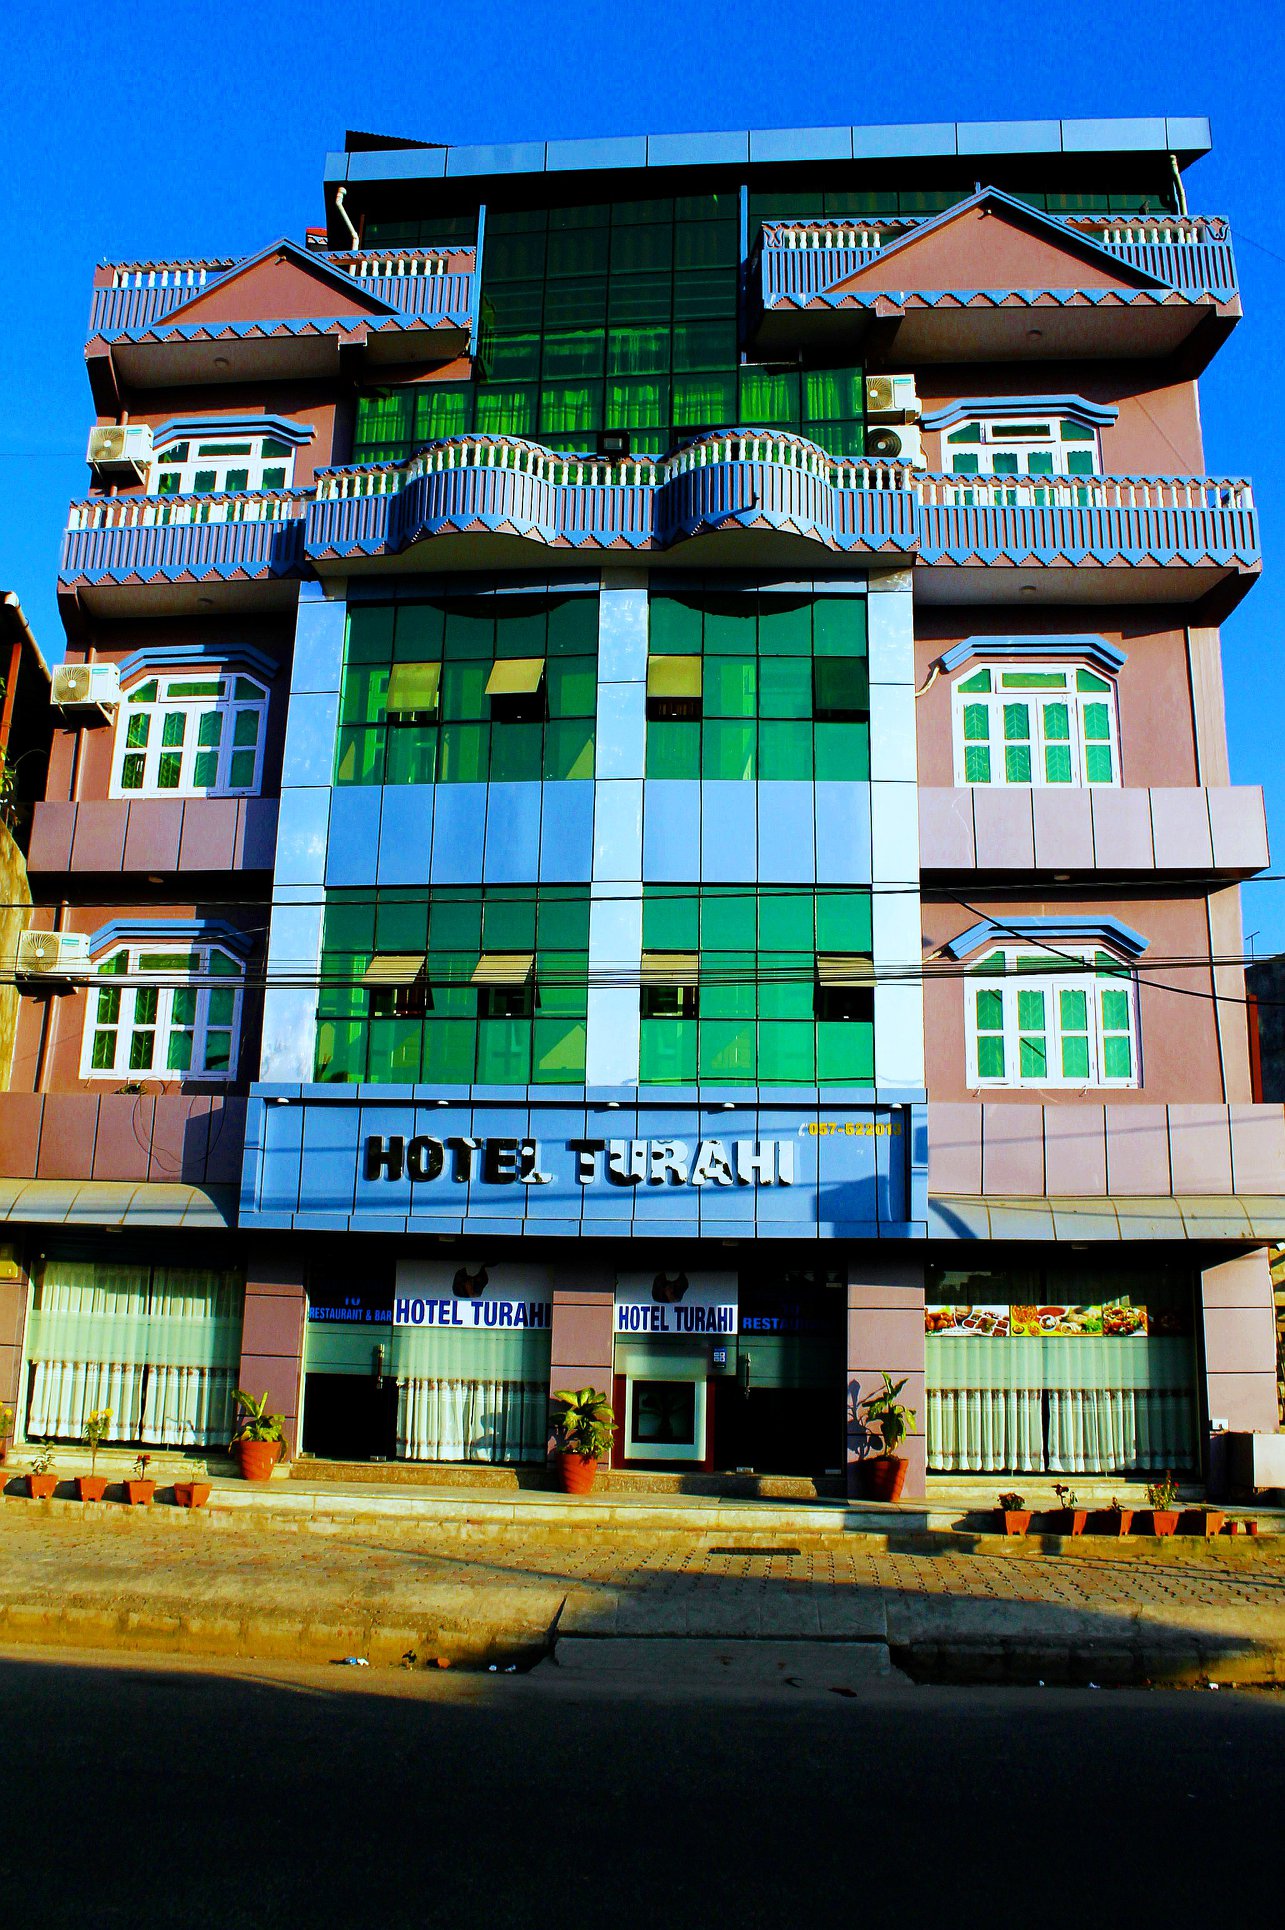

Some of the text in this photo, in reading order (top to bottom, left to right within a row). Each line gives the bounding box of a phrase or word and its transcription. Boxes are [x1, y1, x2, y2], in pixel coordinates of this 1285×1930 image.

[808, 1122, 902, 1136] 057-522013
[365, 1135, 795, 1186] HOTEL TURAHI
[309, 1306, 393, 1322] RESTAURANT & BAR
[396, 1299, 550, 1328] HOTEL TURAHI
[618, 1305, 734, 1333] HOTEL TURAHI
